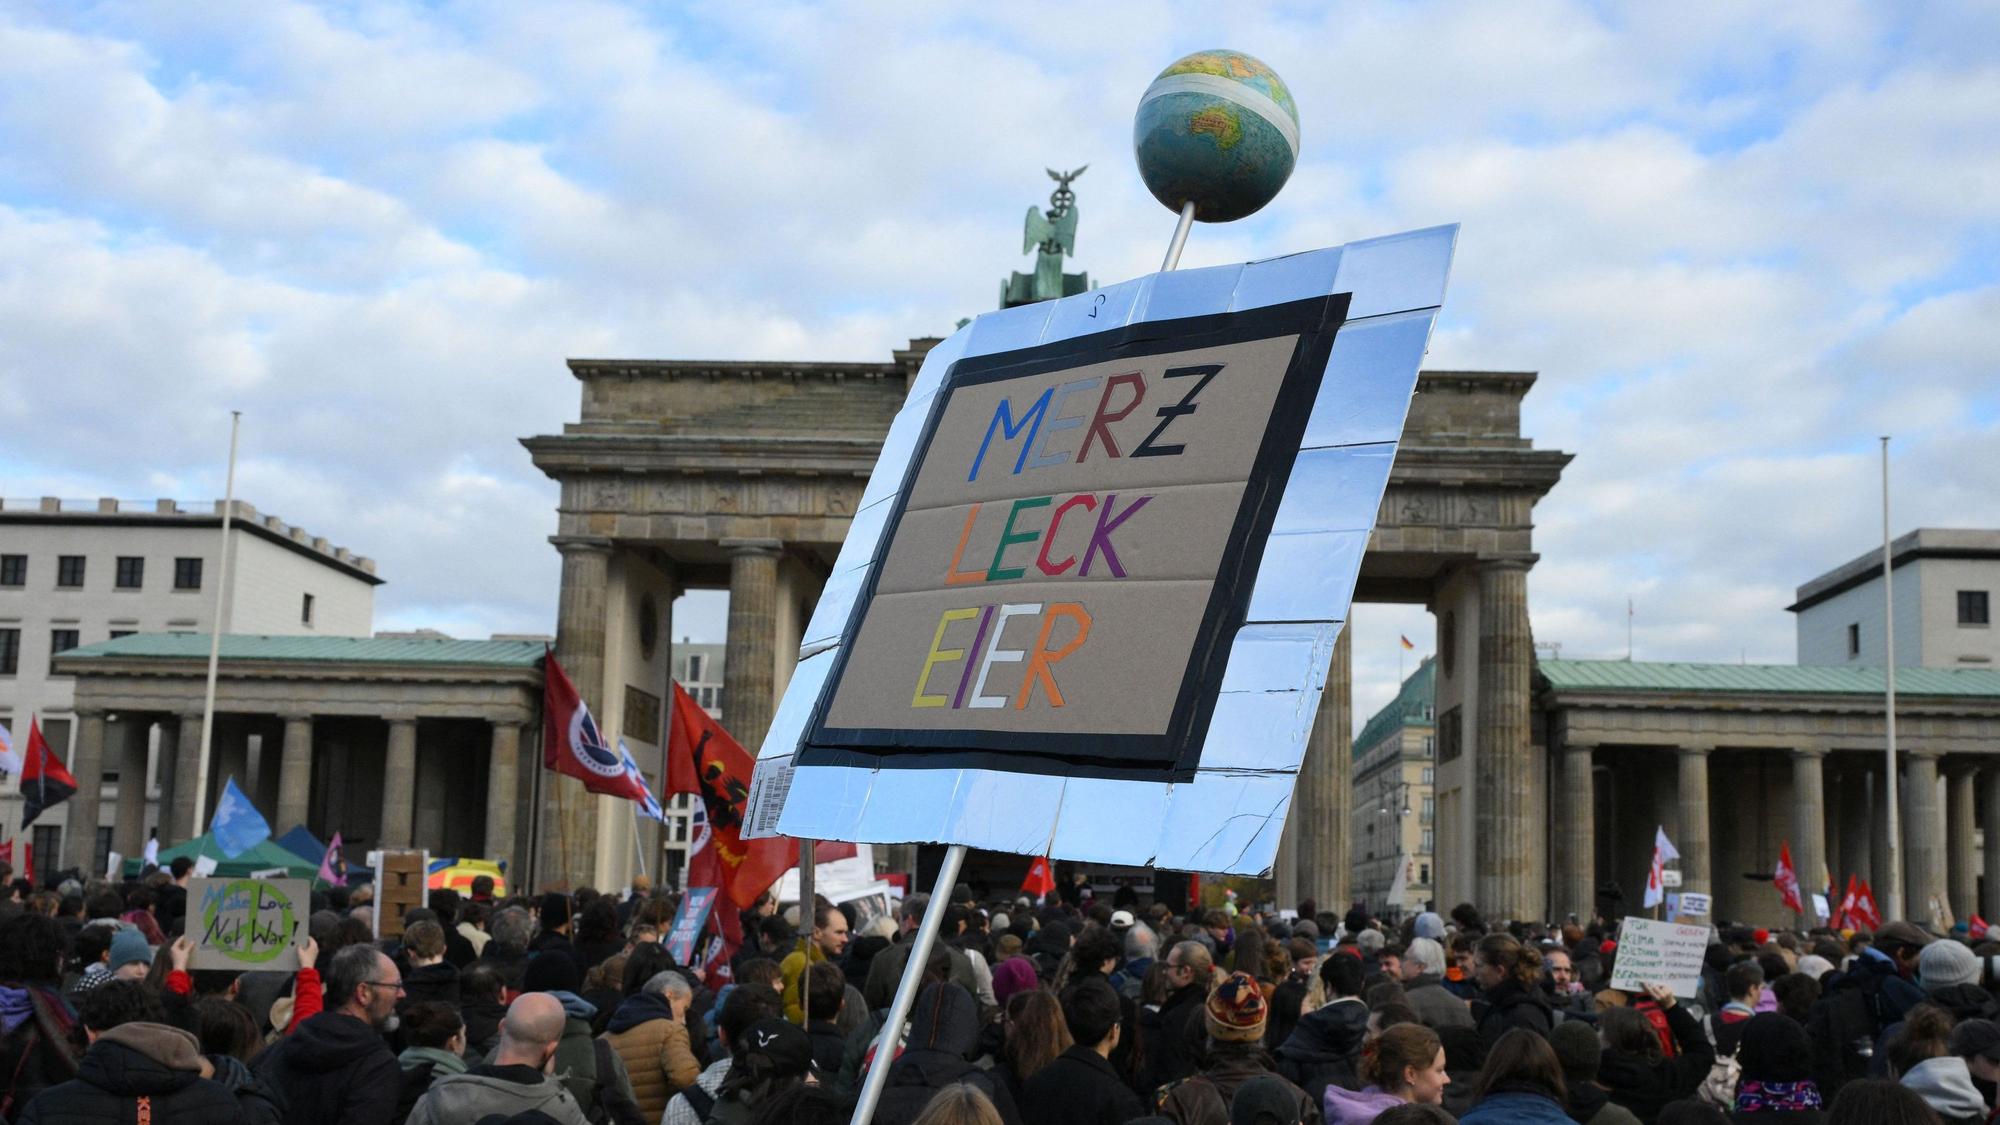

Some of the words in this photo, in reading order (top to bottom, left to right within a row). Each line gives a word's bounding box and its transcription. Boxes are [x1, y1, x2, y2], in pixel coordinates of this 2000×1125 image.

[968, 363, 1228, 482] MERZ
[944, 492, 1156, 584] LECK
[911, 602, 1094, 710] EIER
[201, 914, 243, 946] Not
[251, 919, 299, 946] War!
[258, 884, 293, 911] Love
